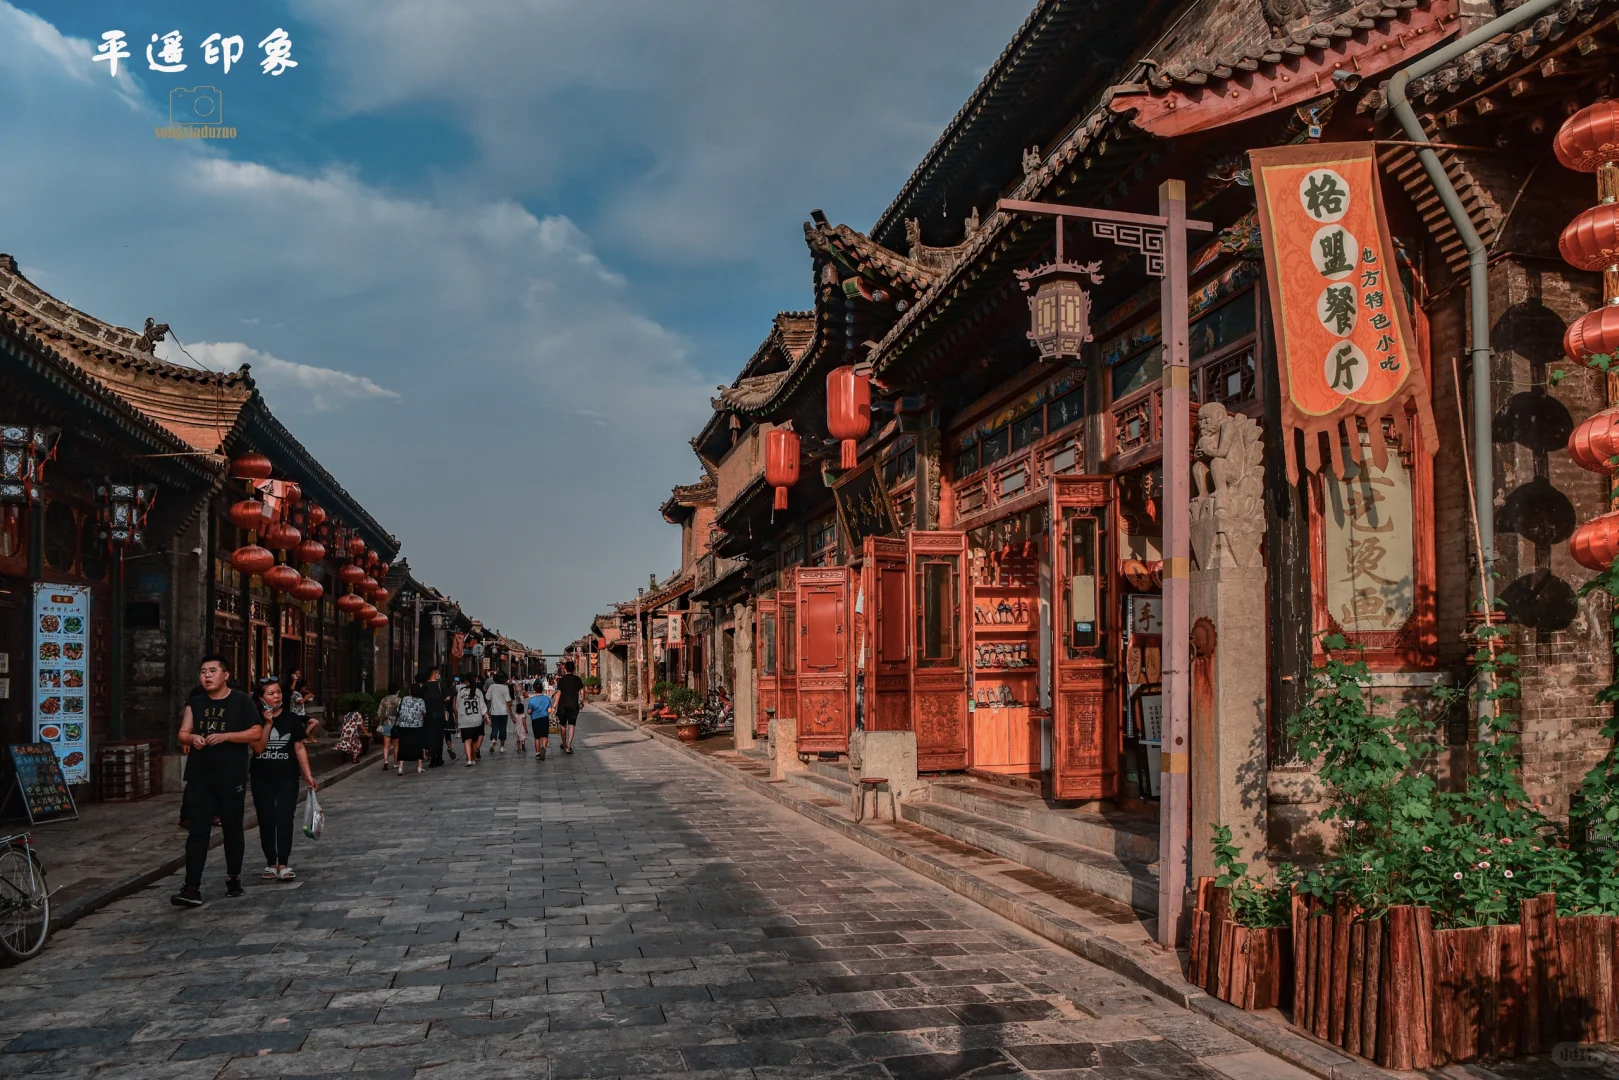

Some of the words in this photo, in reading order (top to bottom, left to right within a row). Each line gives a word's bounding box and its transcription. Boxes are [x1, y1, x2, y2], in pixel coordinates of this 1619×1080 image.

[1303, 173, 1359, 391] 格盟餐厅
[1137, 601, 1162, 632] 手
[204, 707, 226, 718] SIX
[464, 700, 479, 716] 28
